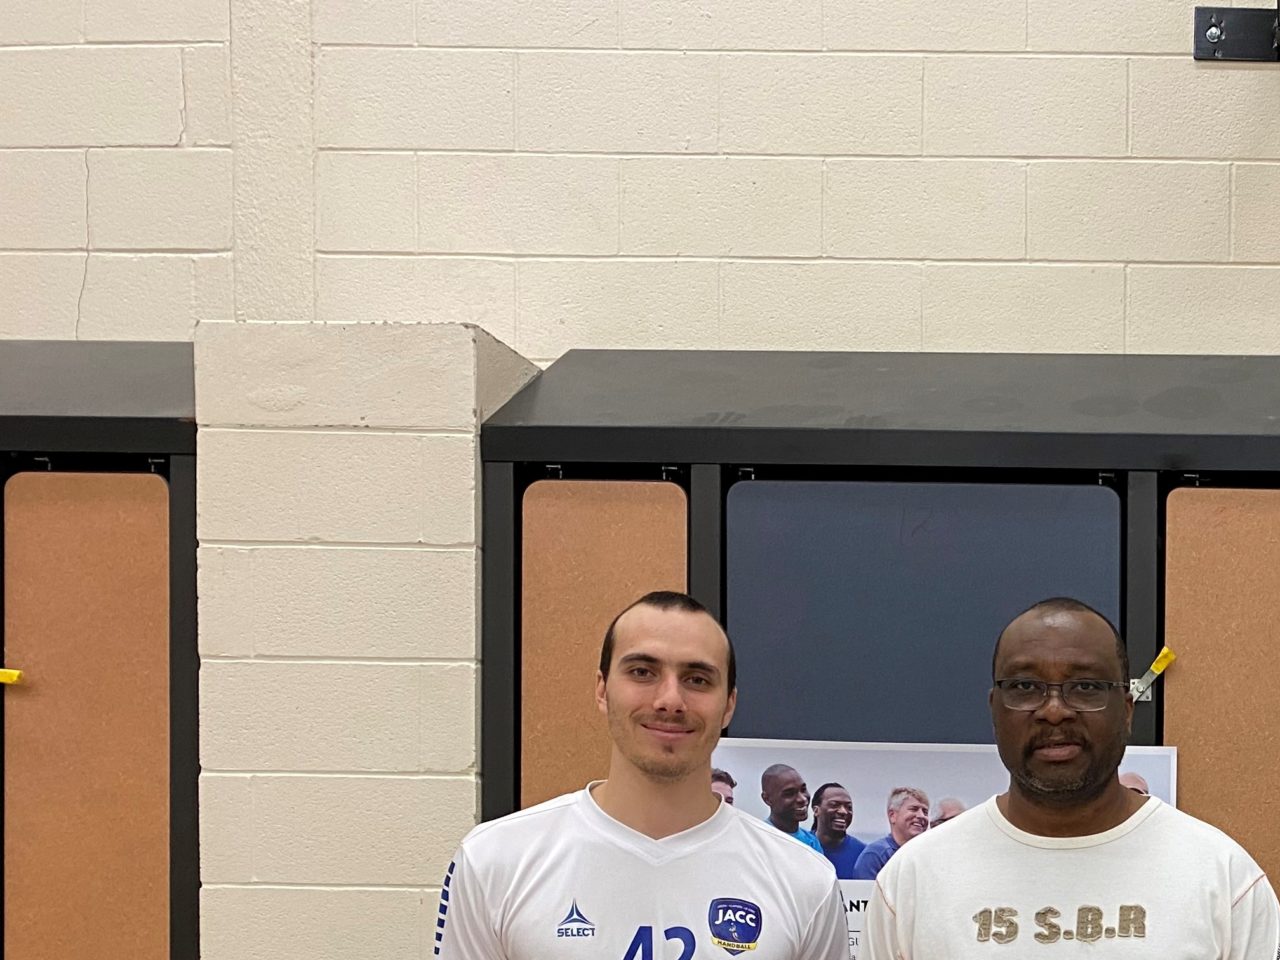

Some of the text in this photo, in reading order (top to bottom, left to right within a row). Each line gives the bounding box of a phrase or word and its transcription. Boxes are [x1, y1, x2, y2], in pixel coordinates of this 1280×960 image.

[714, 909, 756, 927] JACC
[972, 904, 1146, 944] 15 S.B.R
[557, 927, 595, 938] SELECT
